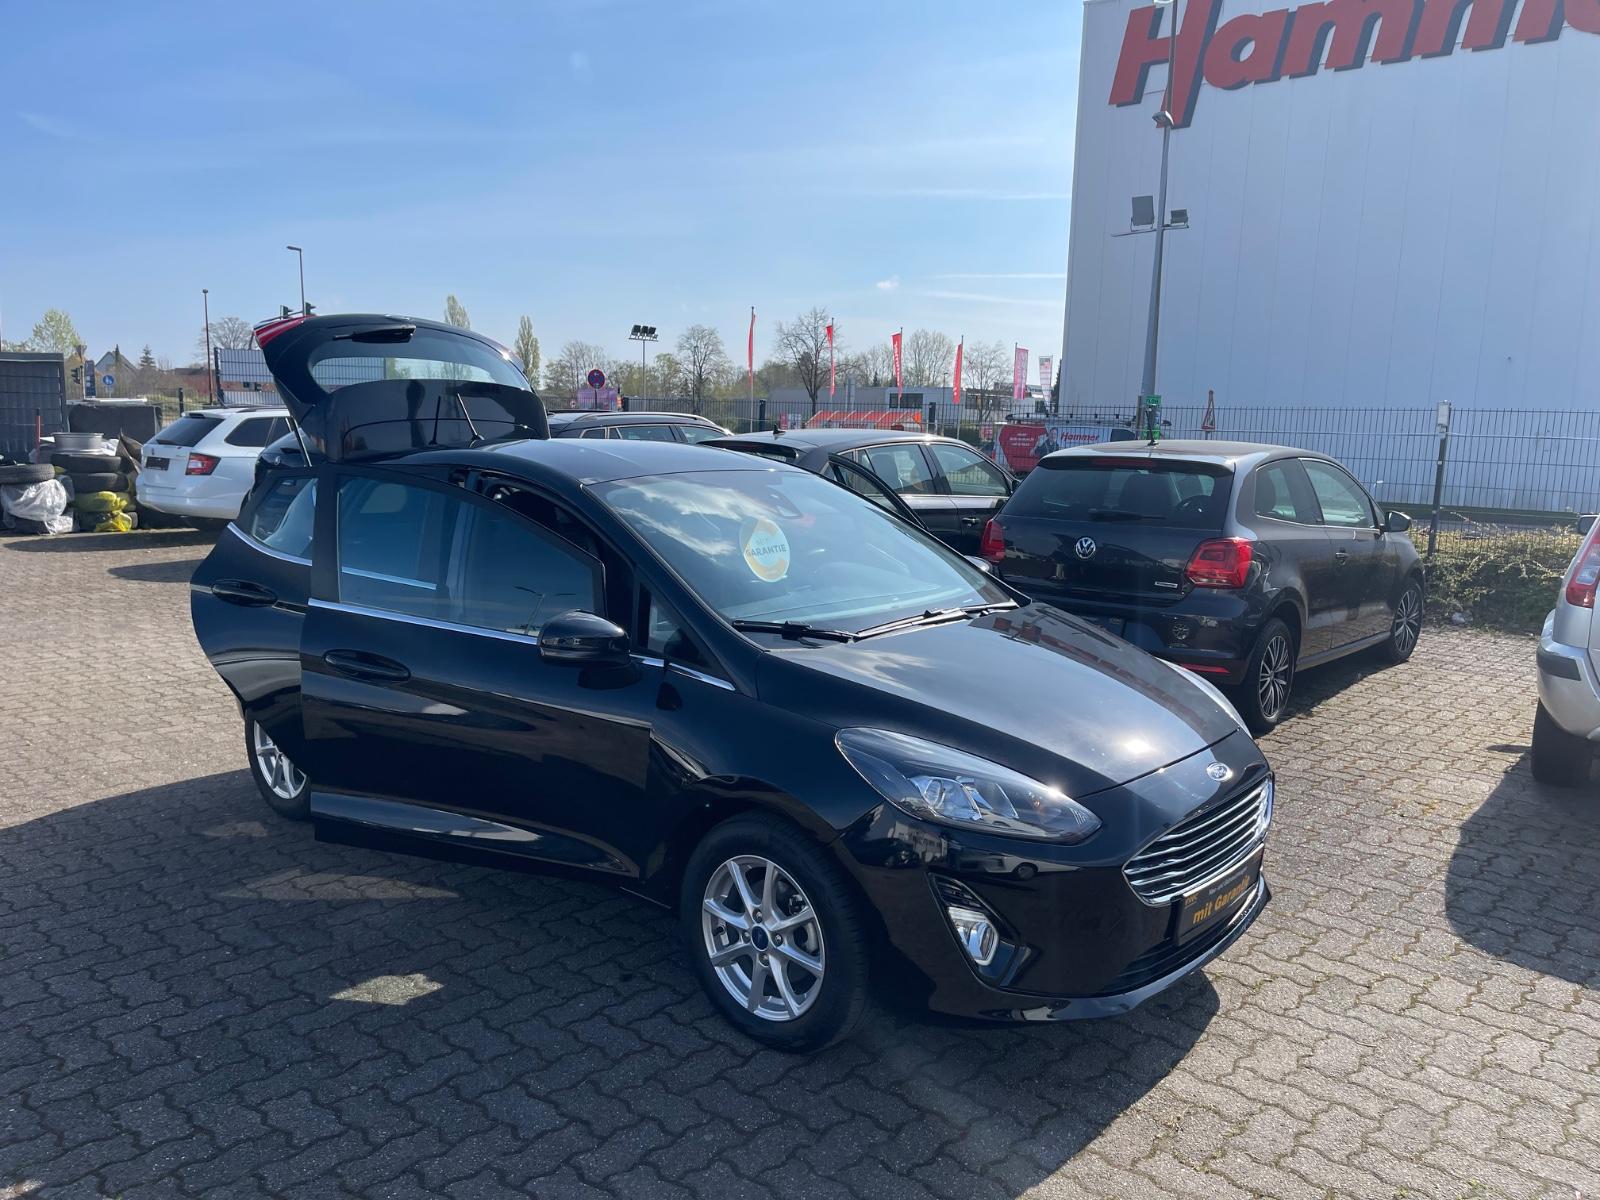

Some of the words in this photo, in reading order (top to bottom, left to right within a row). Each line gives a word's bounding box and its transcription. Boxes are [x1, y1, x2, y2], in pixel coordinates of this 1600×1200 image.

[1061, 431, 1100, 442] Hammer
[745, 543, 787, 557] GARANTIE
[1192, 902, 1213, 925] mit
